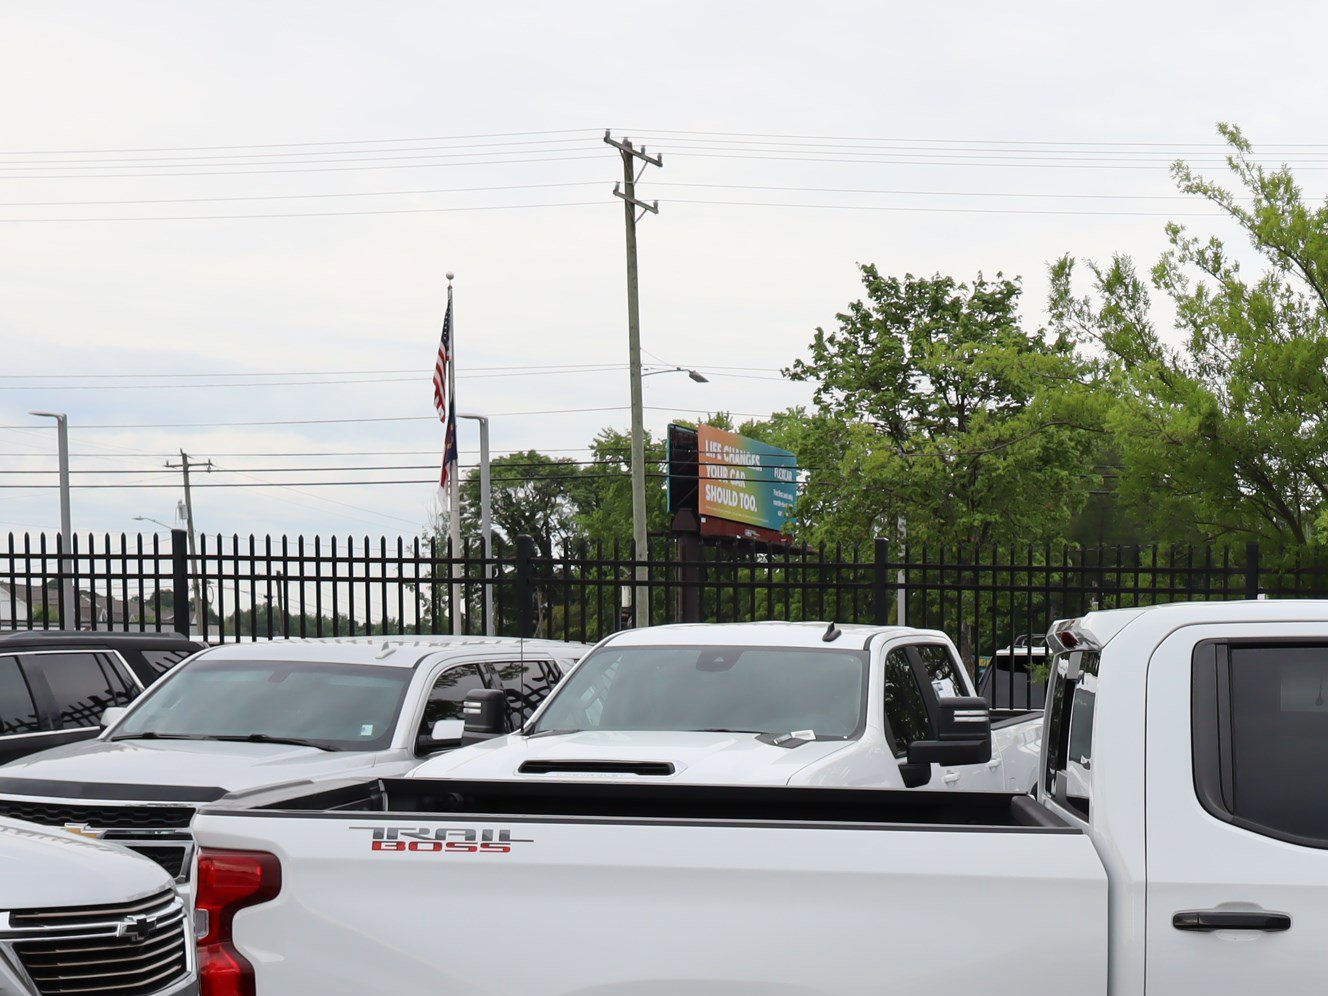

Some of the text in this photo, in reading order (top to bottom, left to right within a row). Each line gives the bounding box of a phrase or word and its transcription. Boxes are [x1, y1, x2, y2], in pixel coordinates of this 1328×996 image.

[705, 440, 722, 460] LIFE
[705, 462, 746, 488] YOUR CAR
[705, 484, 738, 507] SHOULD
[349, 826, 534, 843] TRAIL
[372, 840, 511, 853] BOSS
